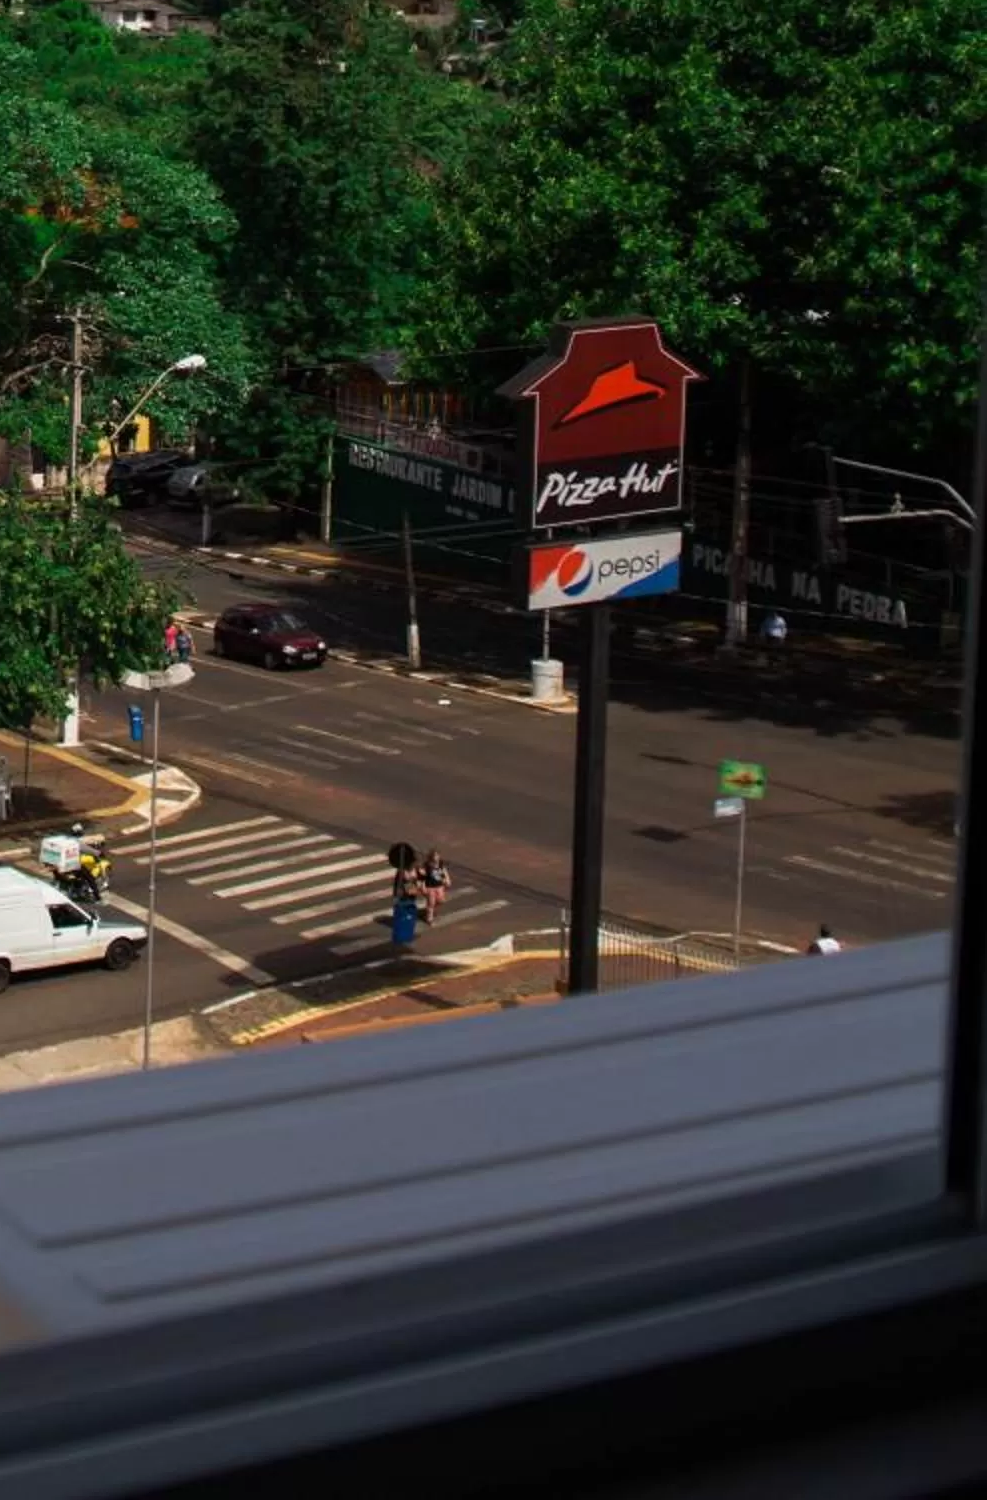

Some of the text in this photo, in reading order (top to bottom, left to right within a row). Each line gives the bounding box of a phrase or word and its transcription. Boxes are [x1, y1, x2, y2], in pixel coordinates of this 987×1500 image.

[348, 442, 443, 493] RESTAURANTE
[536, 470, 617, 513] Pizza
[618, 461, 679, 499] Hut
[598, 550, 661, 584] pepsi
[692, 543, 909, 629] PICAHA NA PEDRA
